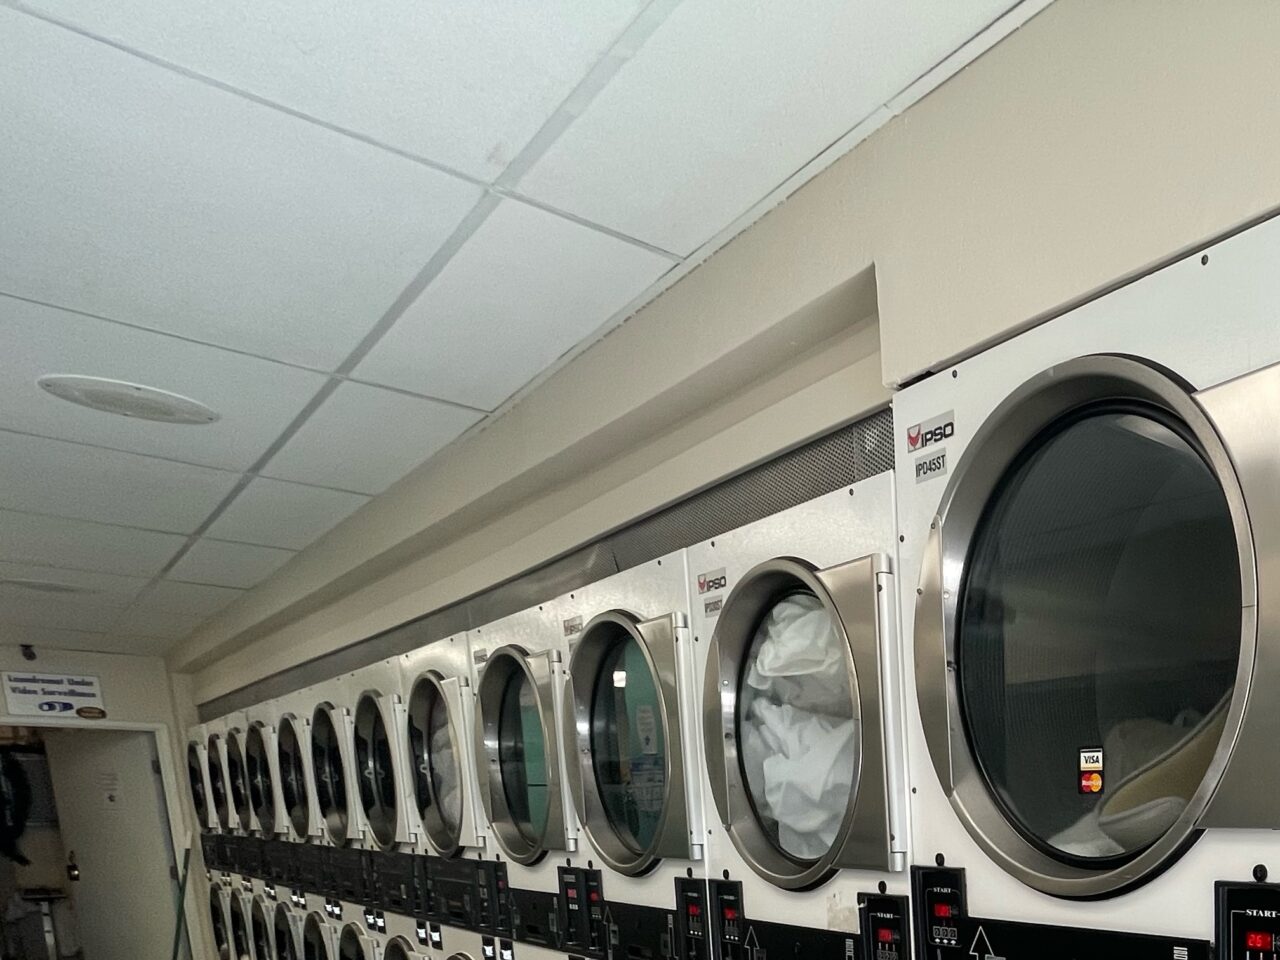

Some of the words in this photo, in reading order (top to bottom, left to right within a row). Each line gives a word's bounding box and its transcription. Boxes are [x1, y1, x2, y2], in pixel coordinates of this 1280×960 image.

[921, 421, 954, 448] IPSO
[915, 454, 946, 478] IPD45ST
[1083, 755, 1100, 764] VISA
[1245, 908, 1278, 918] START
